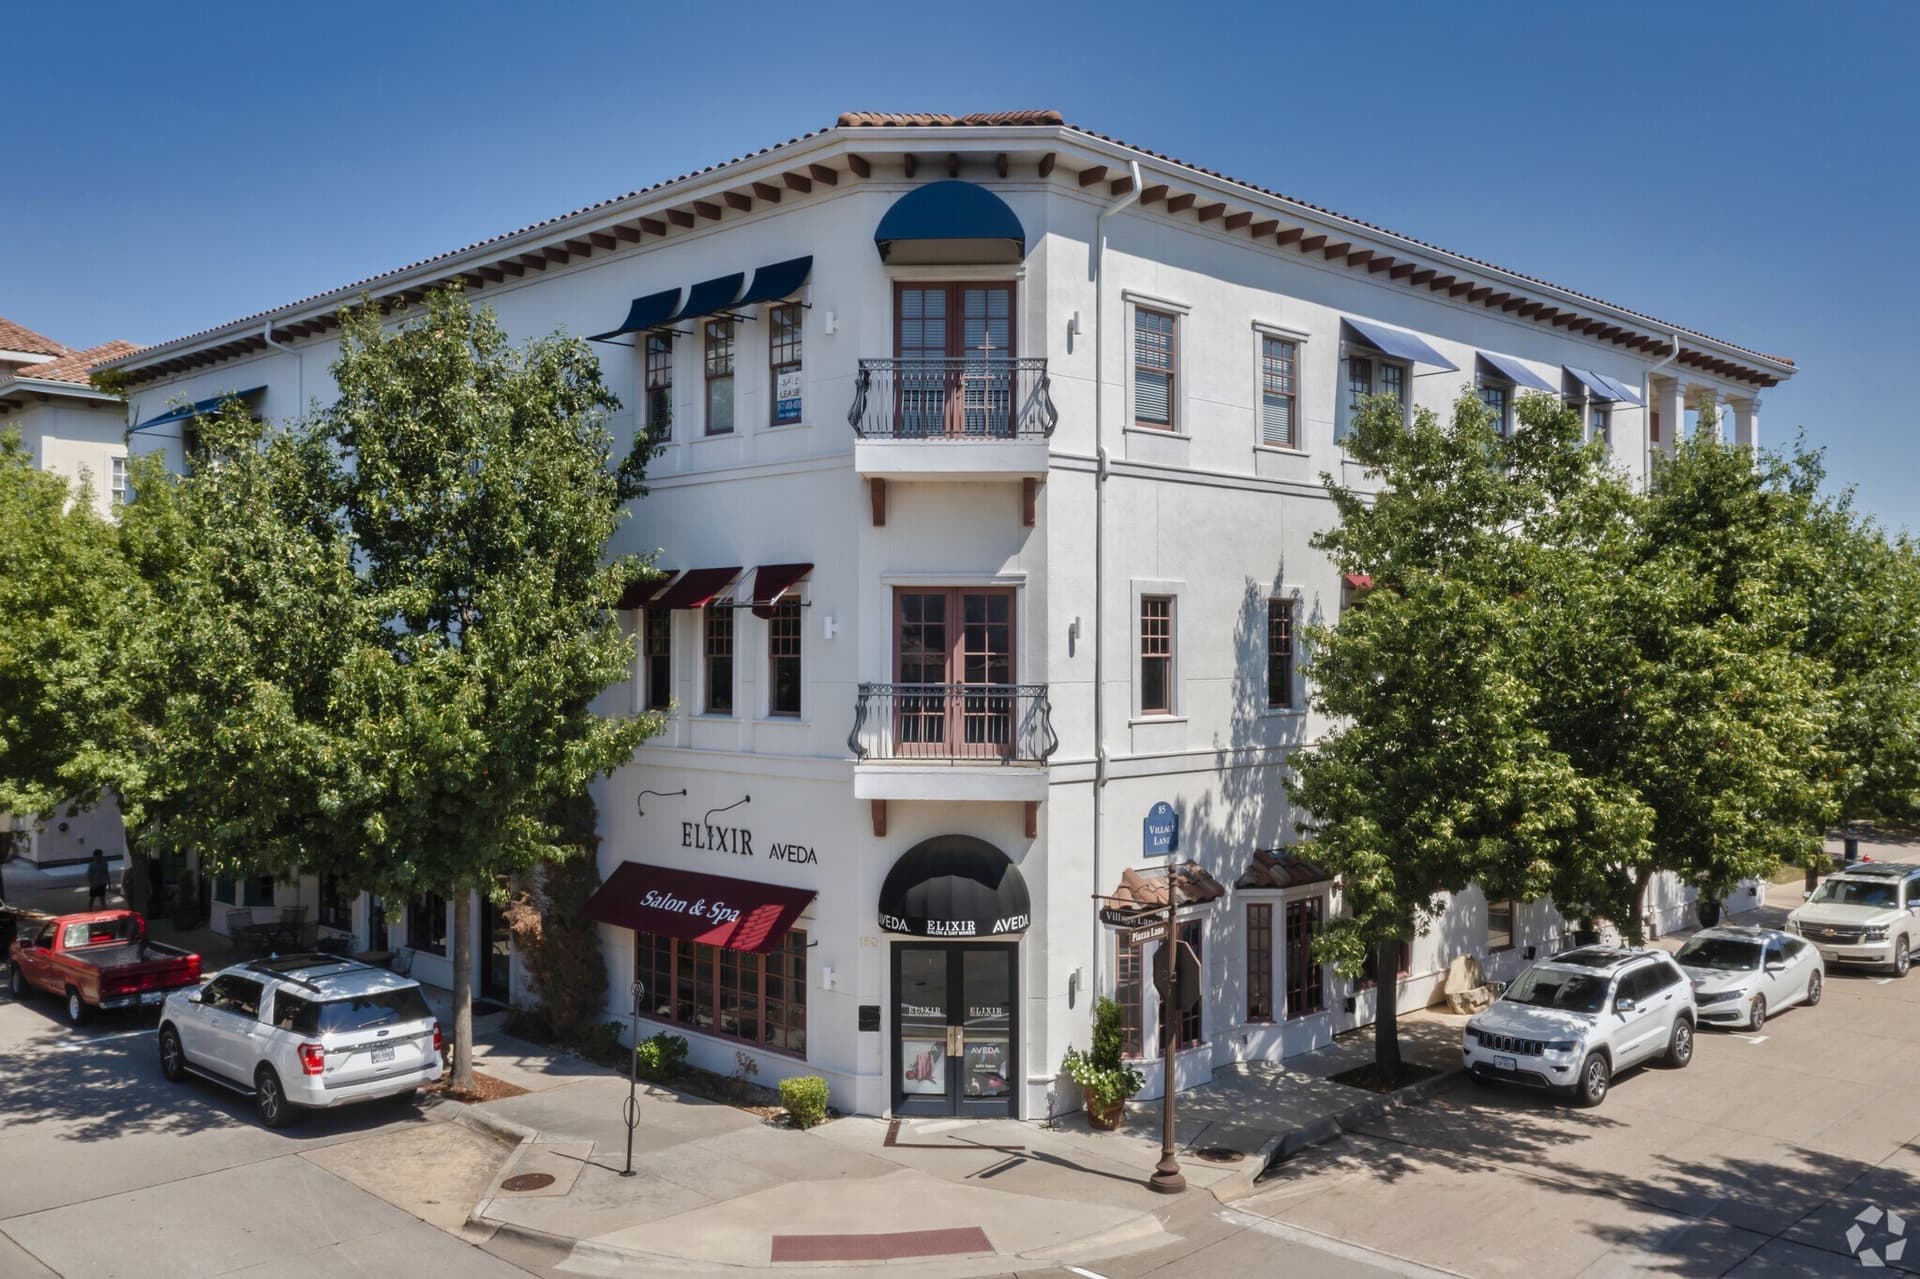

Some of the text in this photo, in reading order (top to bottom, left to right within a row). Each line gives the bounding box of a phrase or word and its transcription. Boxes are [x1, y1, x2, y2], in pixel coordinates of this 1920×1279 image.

[1158, 805, 1166, 815] 85
[681, 822, 753, 856] ELIXIR
[769, 843, 818, 865] AVEDA
[640, 889, 741, 925] Salon & Spa
[927, 920, 976, 931] ELIXIR
[992, 913, 1029, 933] AVEDA
[1132, 927, 1164, 942] Piazza Lane
[970, 1006, 1002, 1014] ELIXIR
